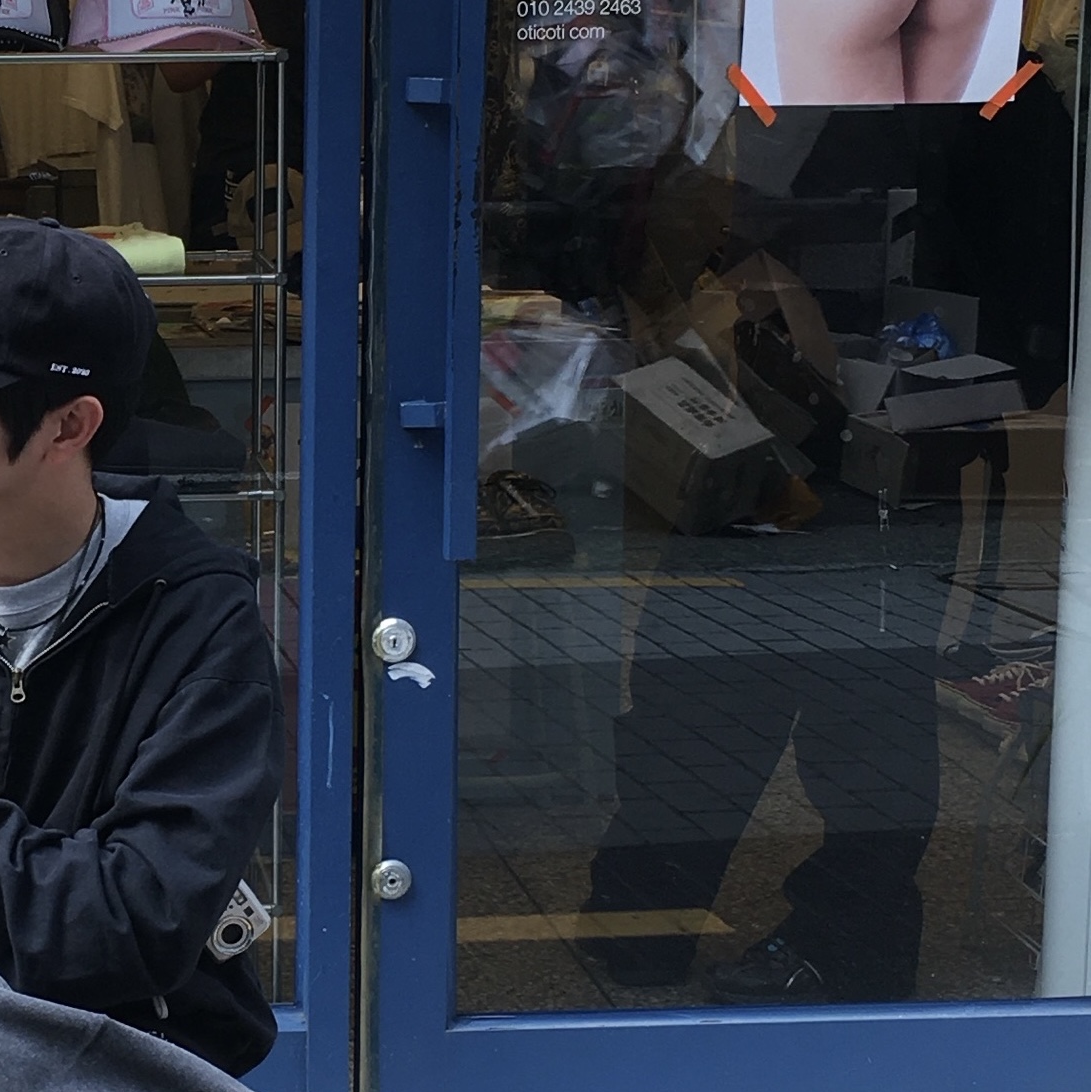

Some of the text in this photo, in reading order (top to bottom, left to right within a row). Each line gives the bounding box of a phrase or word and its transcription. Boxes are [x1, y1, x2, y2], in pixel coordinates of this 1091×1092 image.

[516, 0, 642, 17] 010 2439 2463
[516, 24, 606, 40] oticoti com
